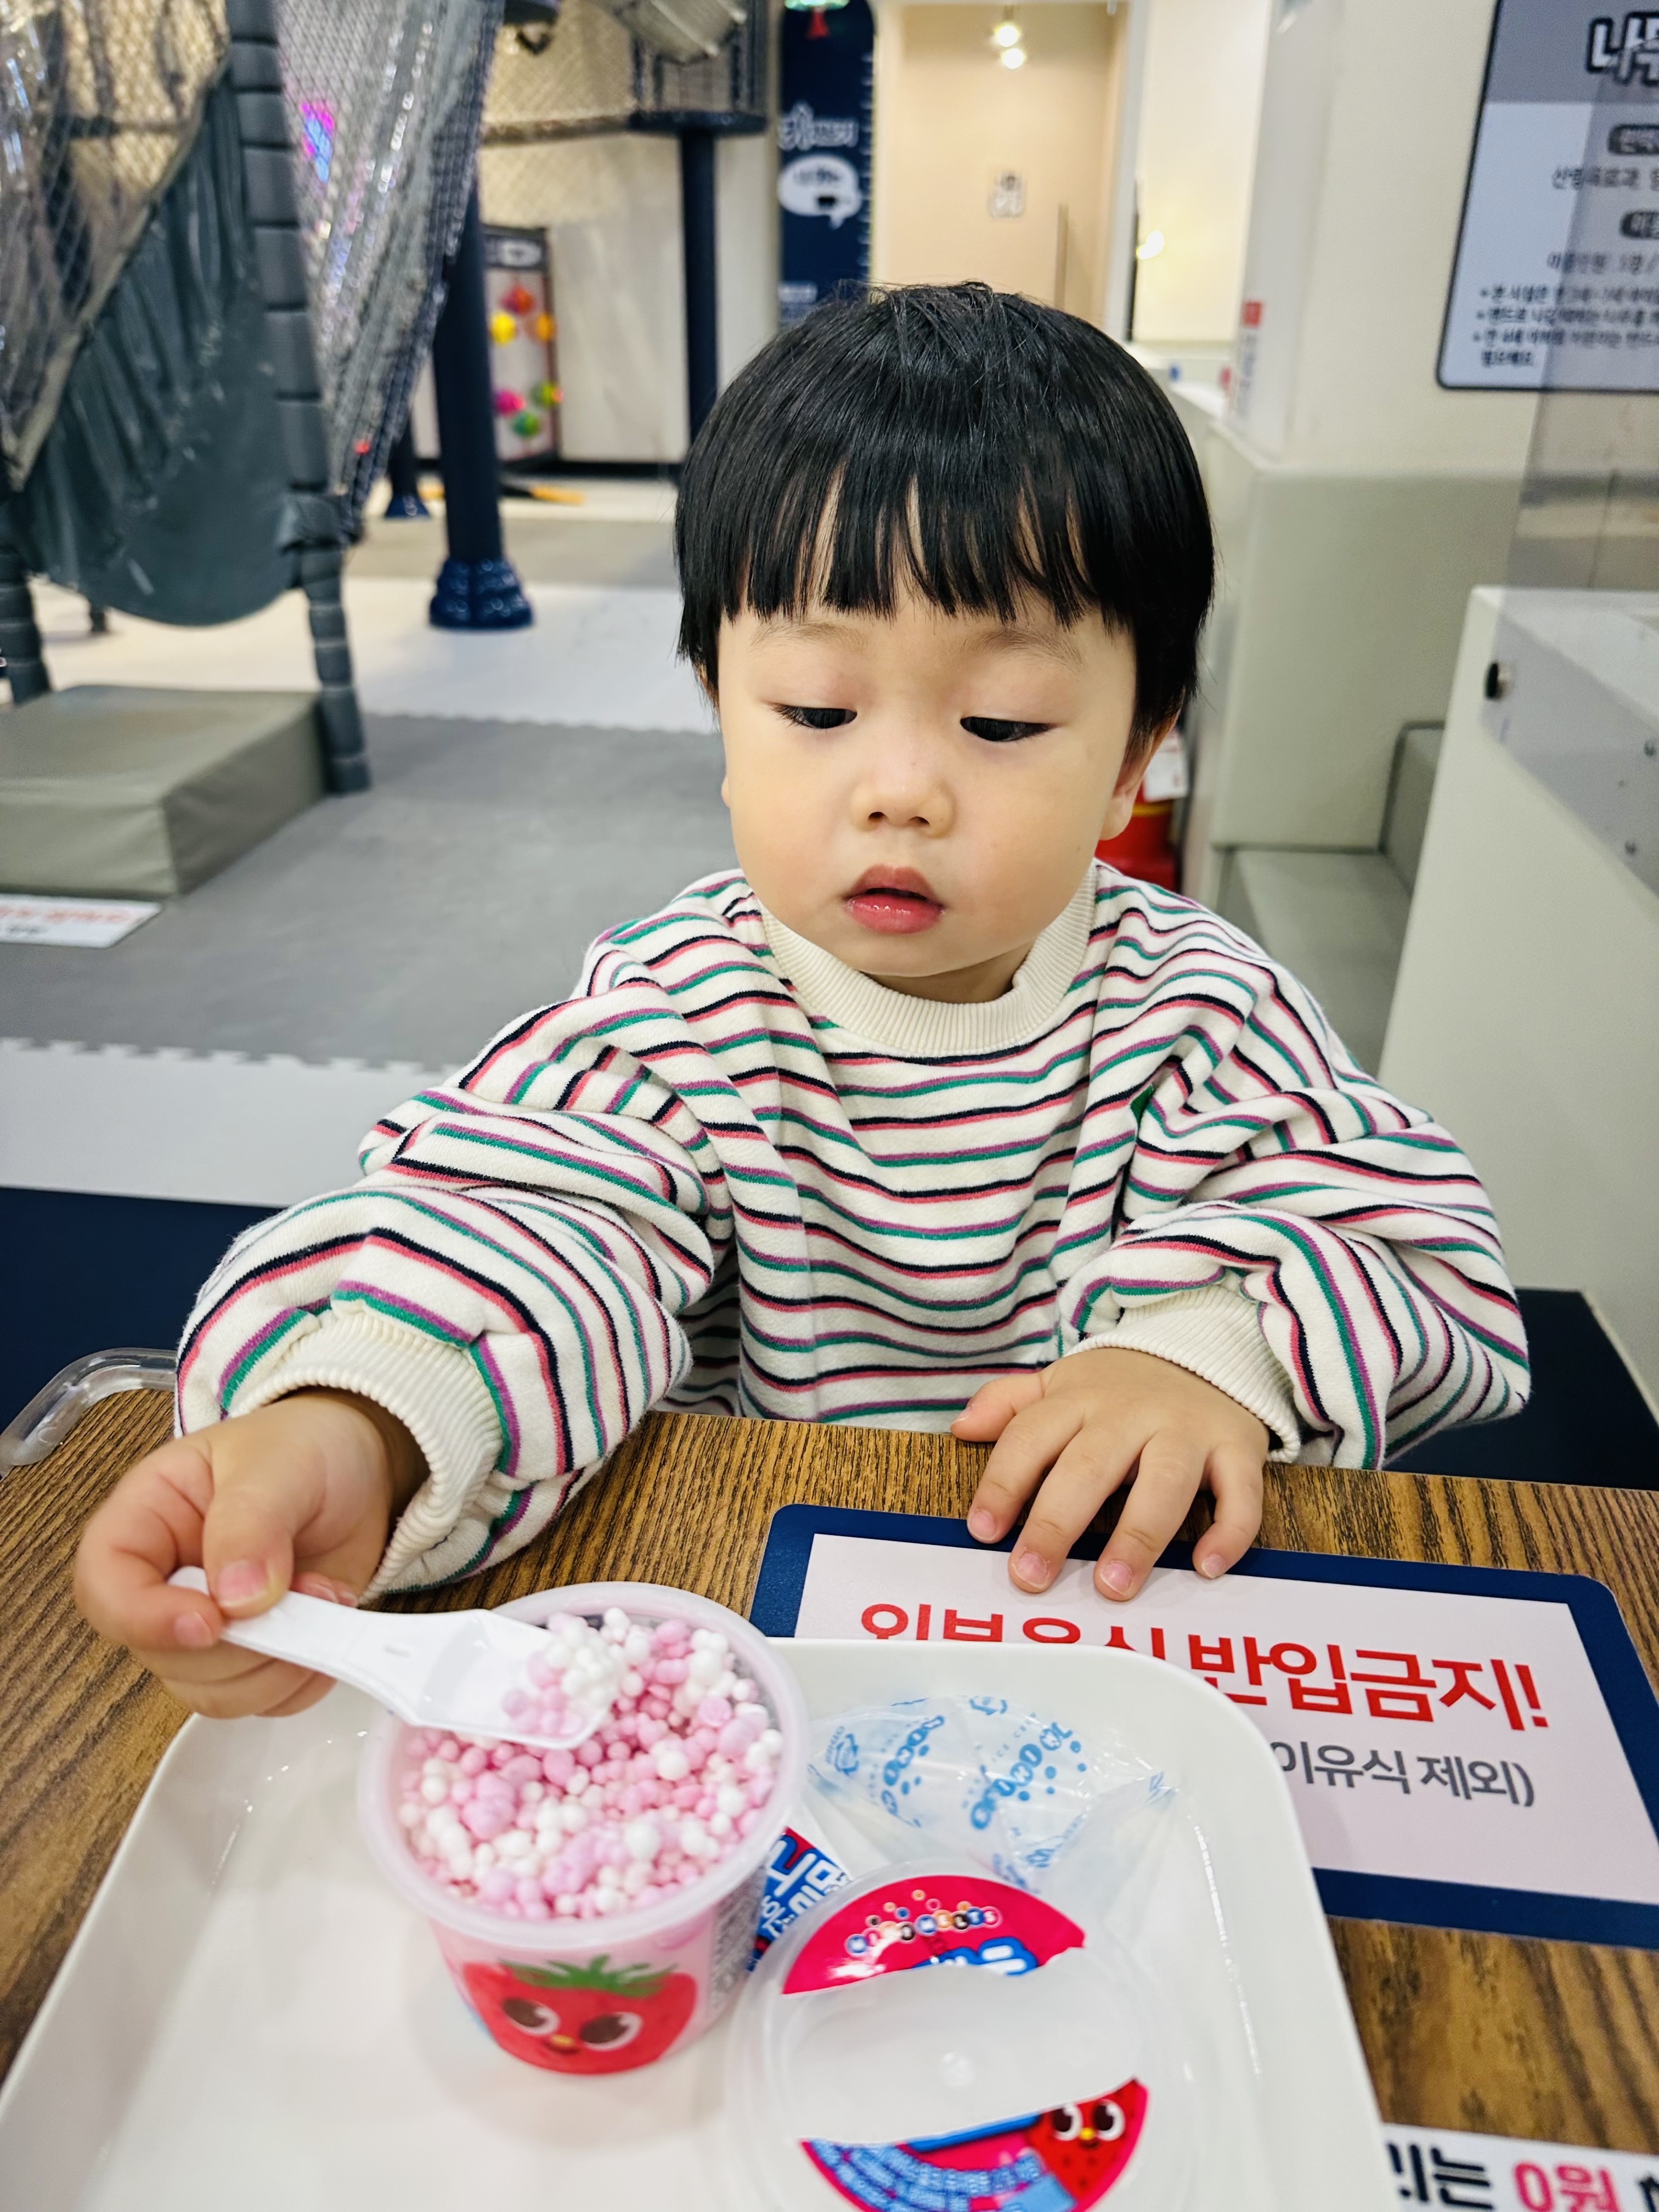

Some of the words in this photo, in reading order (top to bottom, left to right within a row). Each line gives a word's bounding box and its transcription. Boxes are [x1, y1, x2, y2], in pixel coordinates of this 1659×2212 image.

[1188, 1633, 1549, 1731] 반입금지!
[1417, 1756, 1536, 1808] 제외)
[915, 1906, 1003, 1937] MELTS
